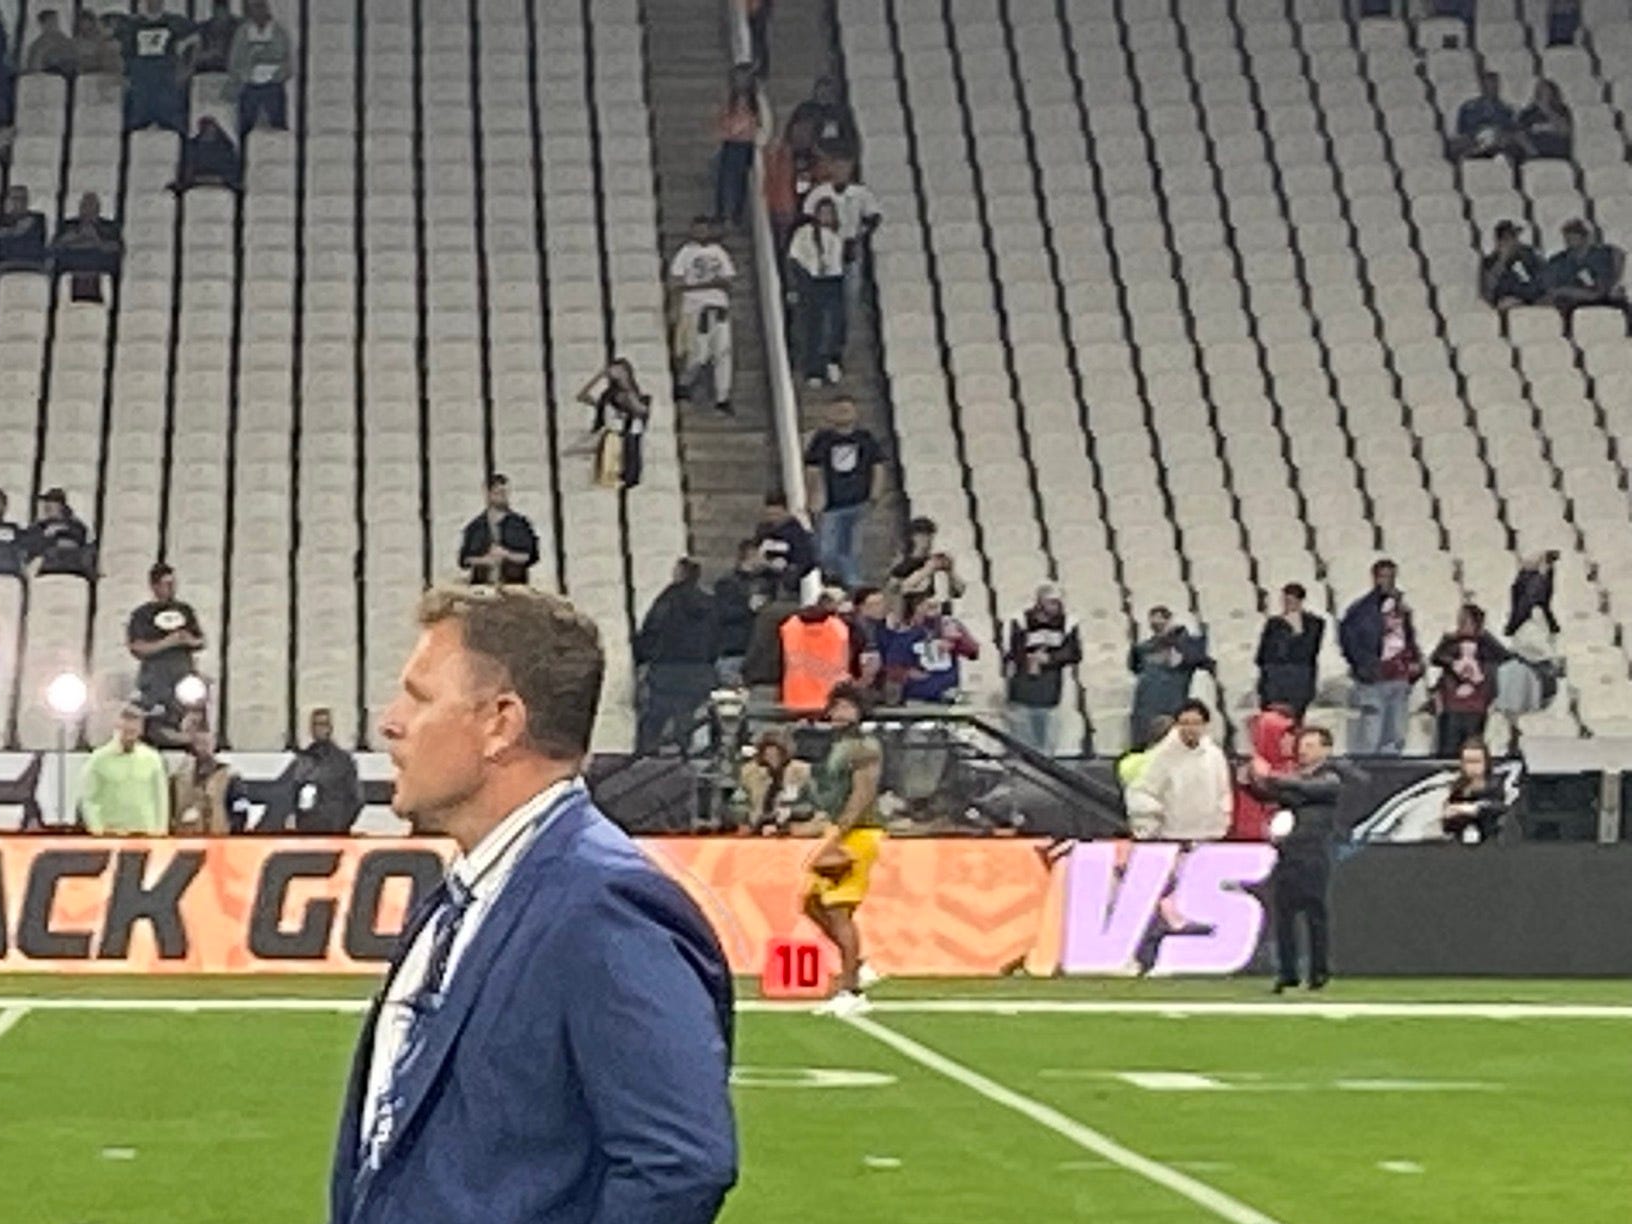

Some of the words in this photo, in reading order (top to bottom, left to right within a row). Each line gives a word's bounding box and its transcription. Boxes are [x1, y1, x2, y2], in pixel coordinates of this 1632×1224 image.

[247, 849, 444, 961] GO
[1062, 841, 1279, 977] VS
[775, 945, 818, 988] 10
